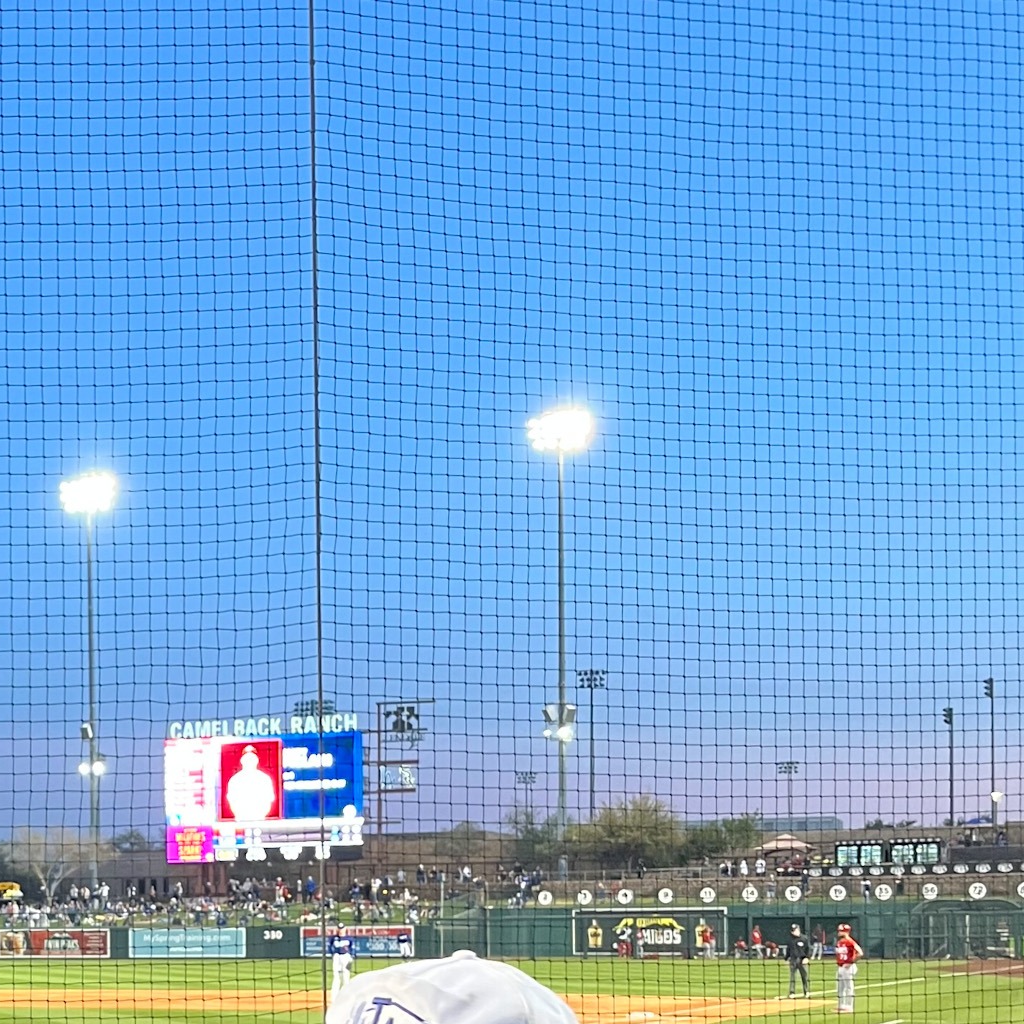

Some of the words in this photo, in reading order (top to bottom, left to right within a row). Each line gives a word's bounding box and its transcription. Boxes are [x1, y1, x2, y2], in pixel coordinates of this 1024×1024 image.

[169, 718, 282, 739] CAMELBACK
[290, 713, 358, 734] RANCH
[143, 934, 231, 943] MySpringTraining.com
[642, 928, 682, 945] MIGOS
